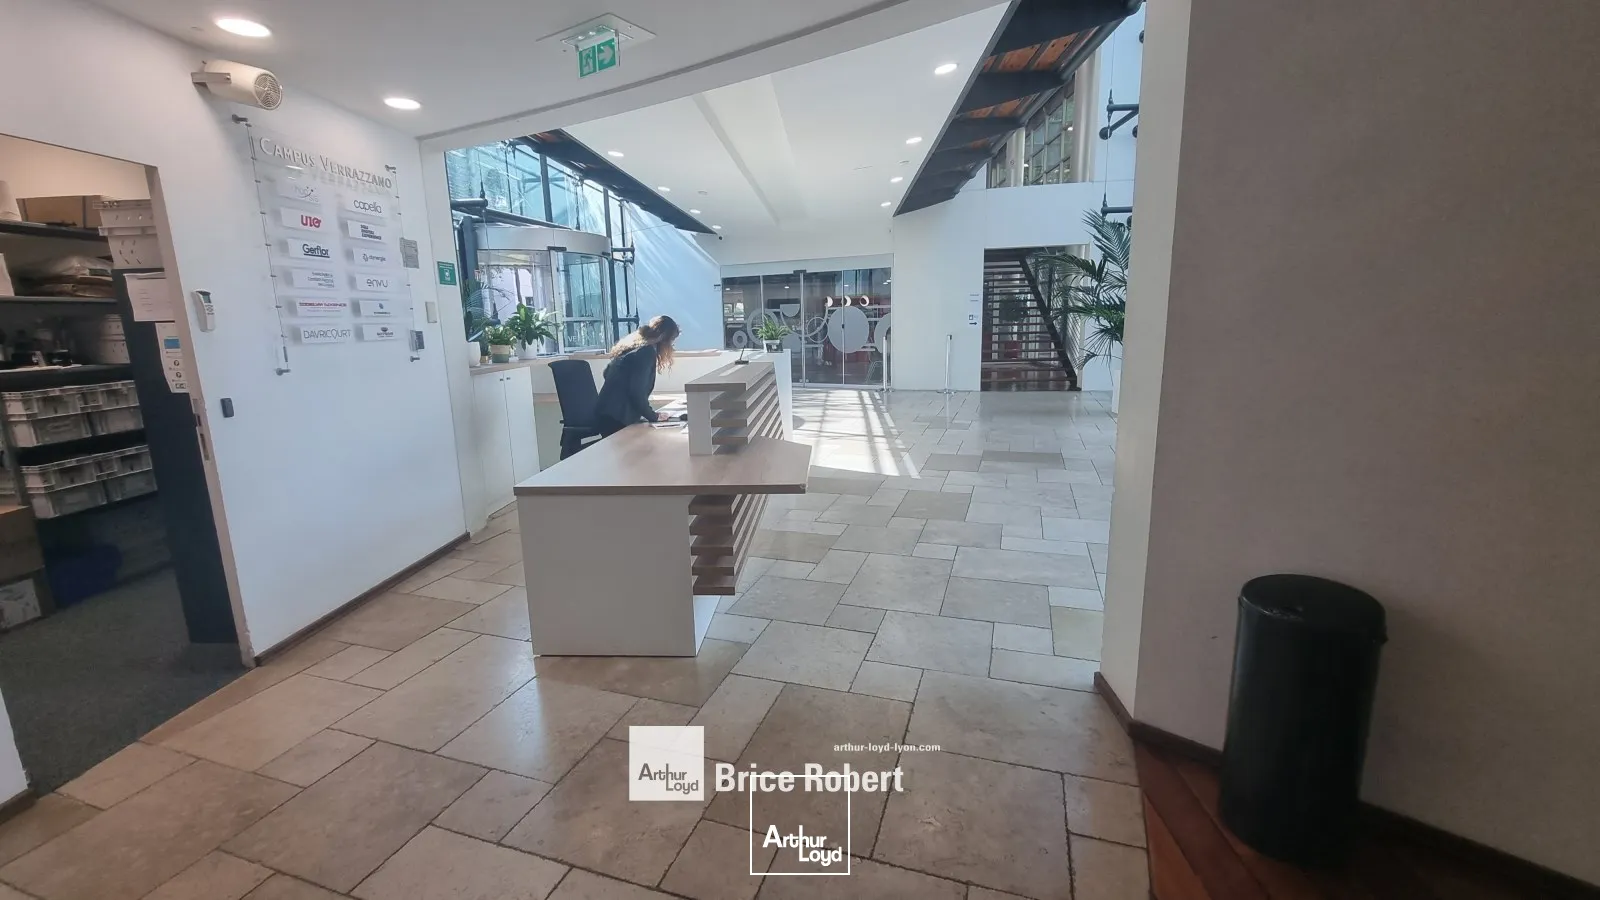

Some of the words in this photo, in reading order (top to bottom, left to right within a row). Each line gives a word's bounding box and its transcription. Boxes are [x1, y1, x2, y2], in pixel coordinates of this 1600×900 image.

[259, 137, 315, 167] CAMPUS
[318, 155, 392, 189] VERRAZZANO
[353, 199, 382, 214] capella
[302, 243, 330, 257] Gerflor
[303, 328, 352, 340] DAVRICOURT
